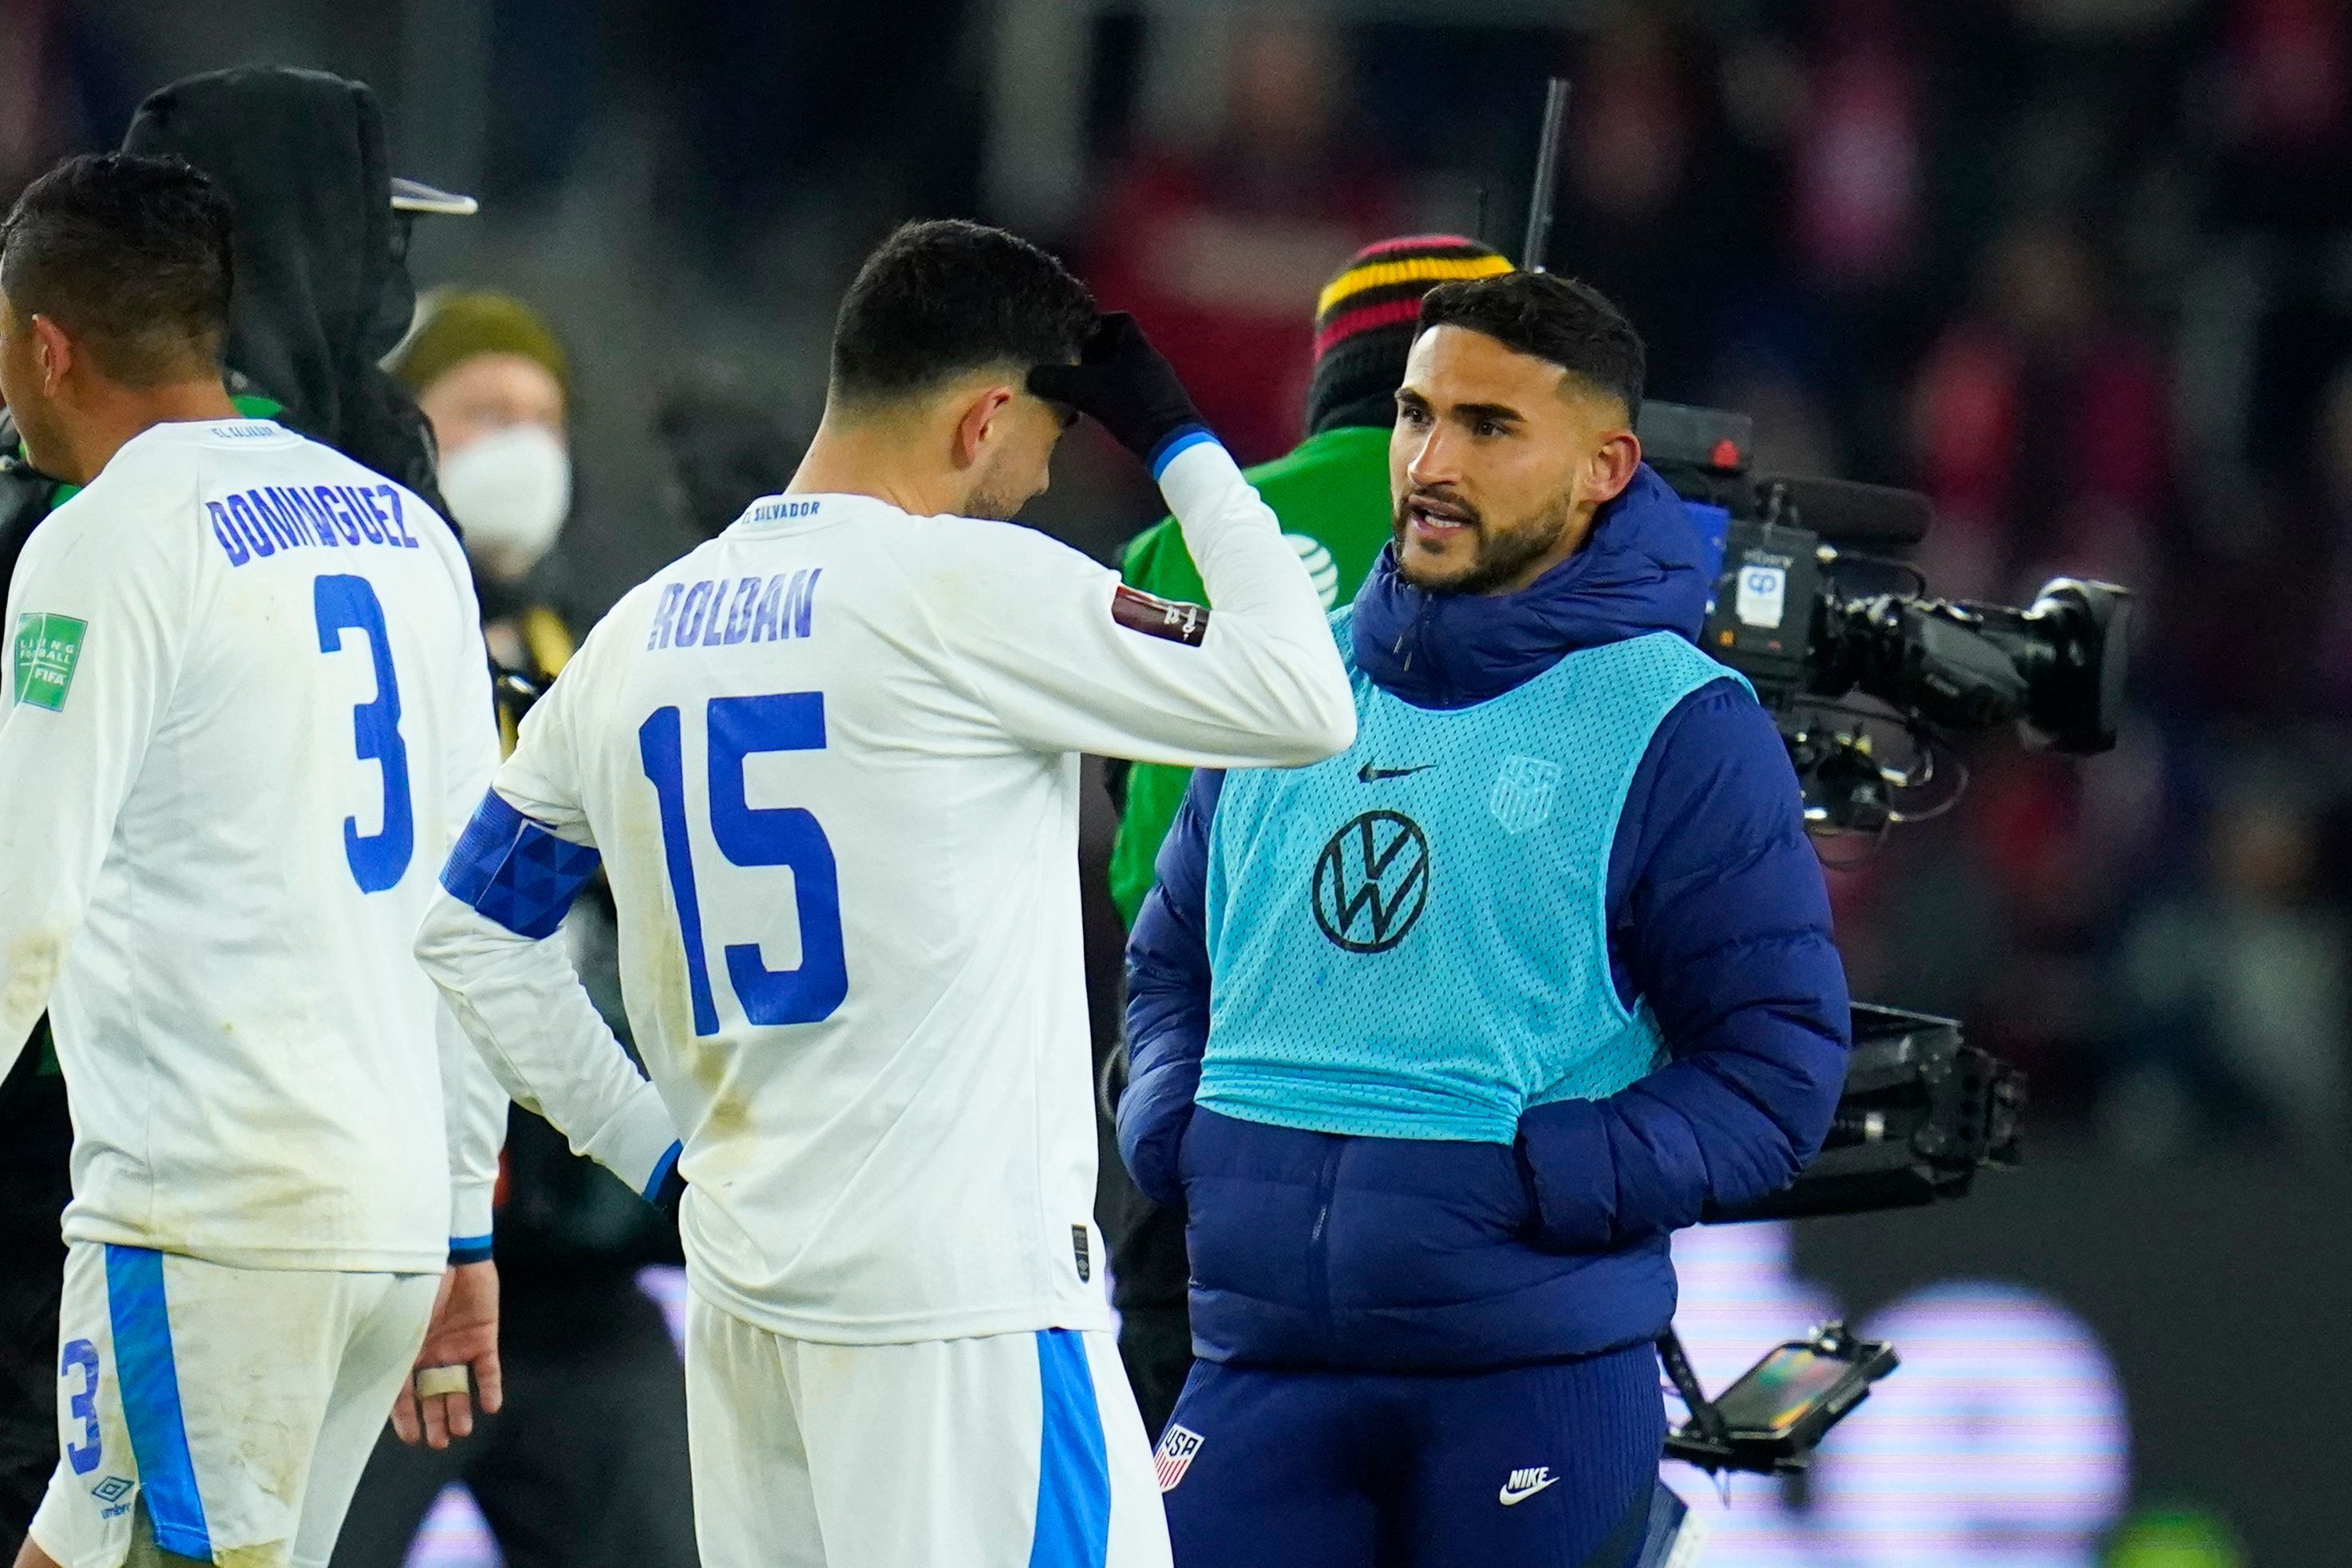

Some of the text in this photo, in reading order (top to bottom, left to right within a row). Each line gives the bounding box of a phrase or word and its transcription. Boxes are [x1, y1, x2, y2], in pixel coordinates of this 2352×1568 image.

[204, 484, 419, 567] DOMINGUEZ
[753, 501, 820, 522] SALVADOR
[646, 567, 823, 651] ROLDAN
[34, 667, 65, 686] FIFA
[314, 574, 413, 895] 3
[638, 691, 848, 1037] 15
[61, 1338, 102, 1475] 3
[1165, 1427, 1199, 1457] USA
[1508, 1467, 1549, 1490] NIKE
